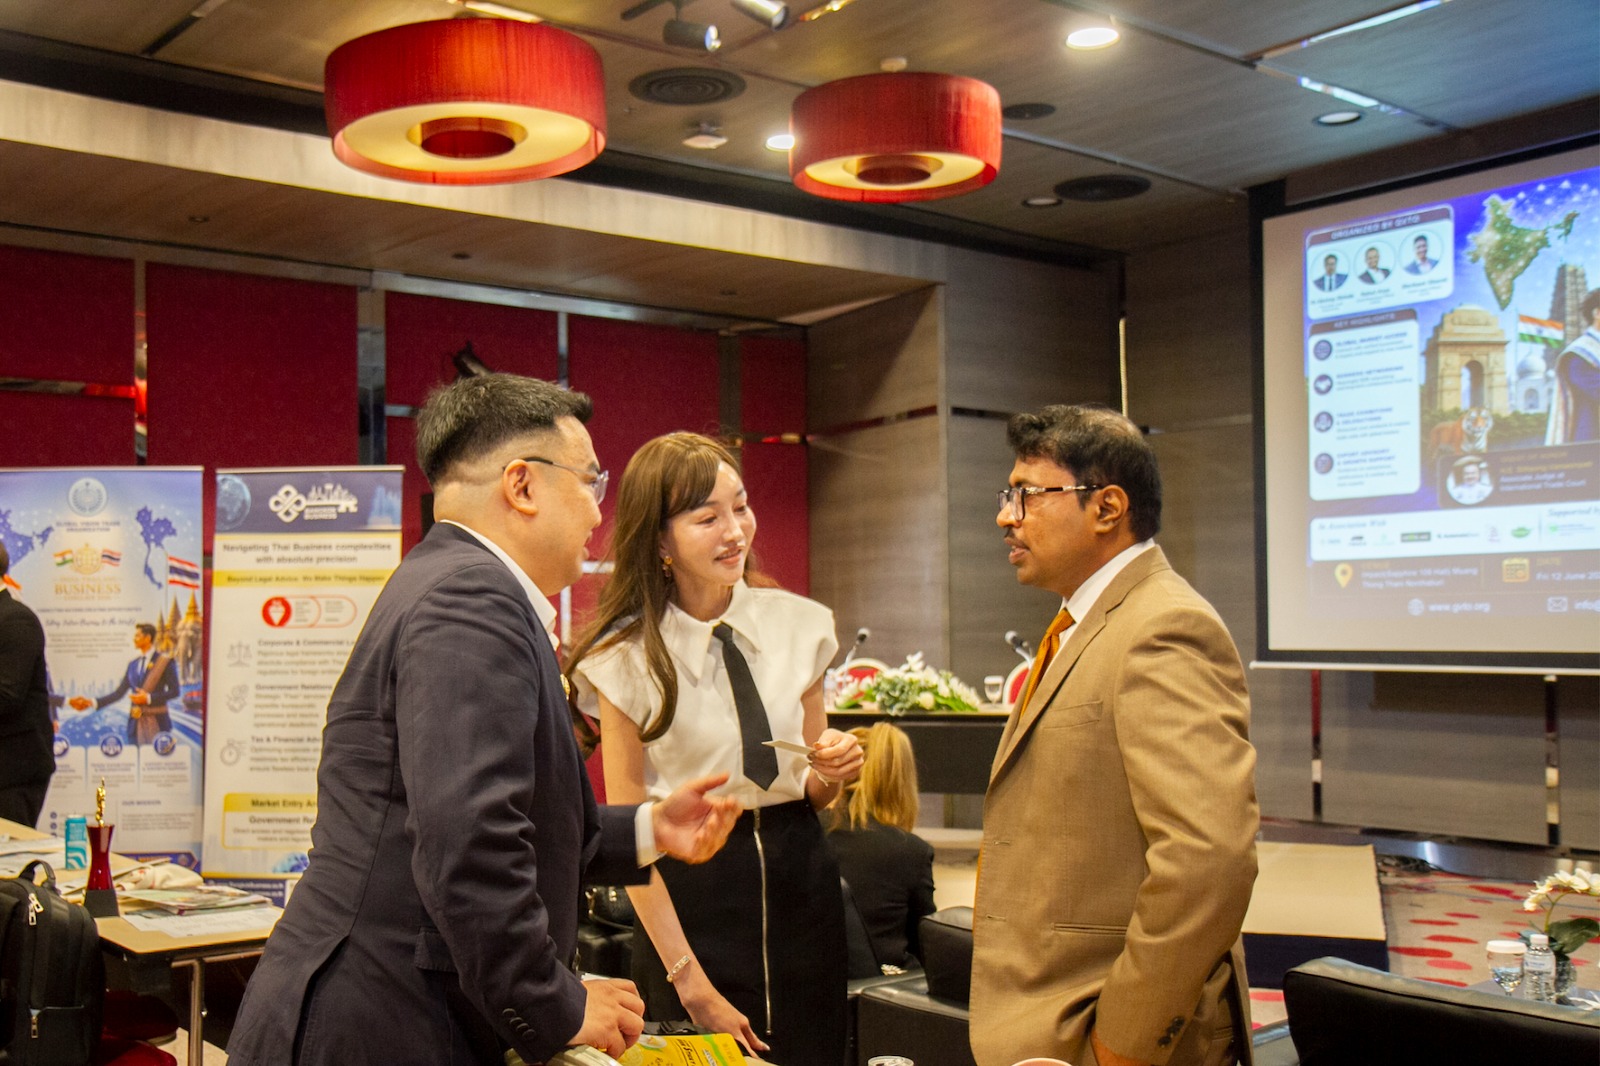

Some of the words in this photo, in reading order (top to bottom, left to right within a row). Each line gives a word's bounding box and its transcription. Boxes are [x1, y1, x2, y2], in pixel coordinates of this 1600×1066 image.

[1331, 222, 1379, 239] ORGANIZED
[223, 543, 269, 553] Navigating
[272, 542, 291, 551] Thai
[293, 543, 333, 551] Business
[335, 542, 392, 553] complexities
[256, 556, 274, 564] with
[276, 555, 313, 564] absolute
[316, 555, 358, 565] precision
[54, 583, 121, 595] BUSINESS
[258, 640, 293, 648] Corporate
[303, 639, 343, 647] Commercial
[251, 800, 280, 808] Market
[282, 799, 303, 810] Entry
[249, 815, 301, 825] Government
